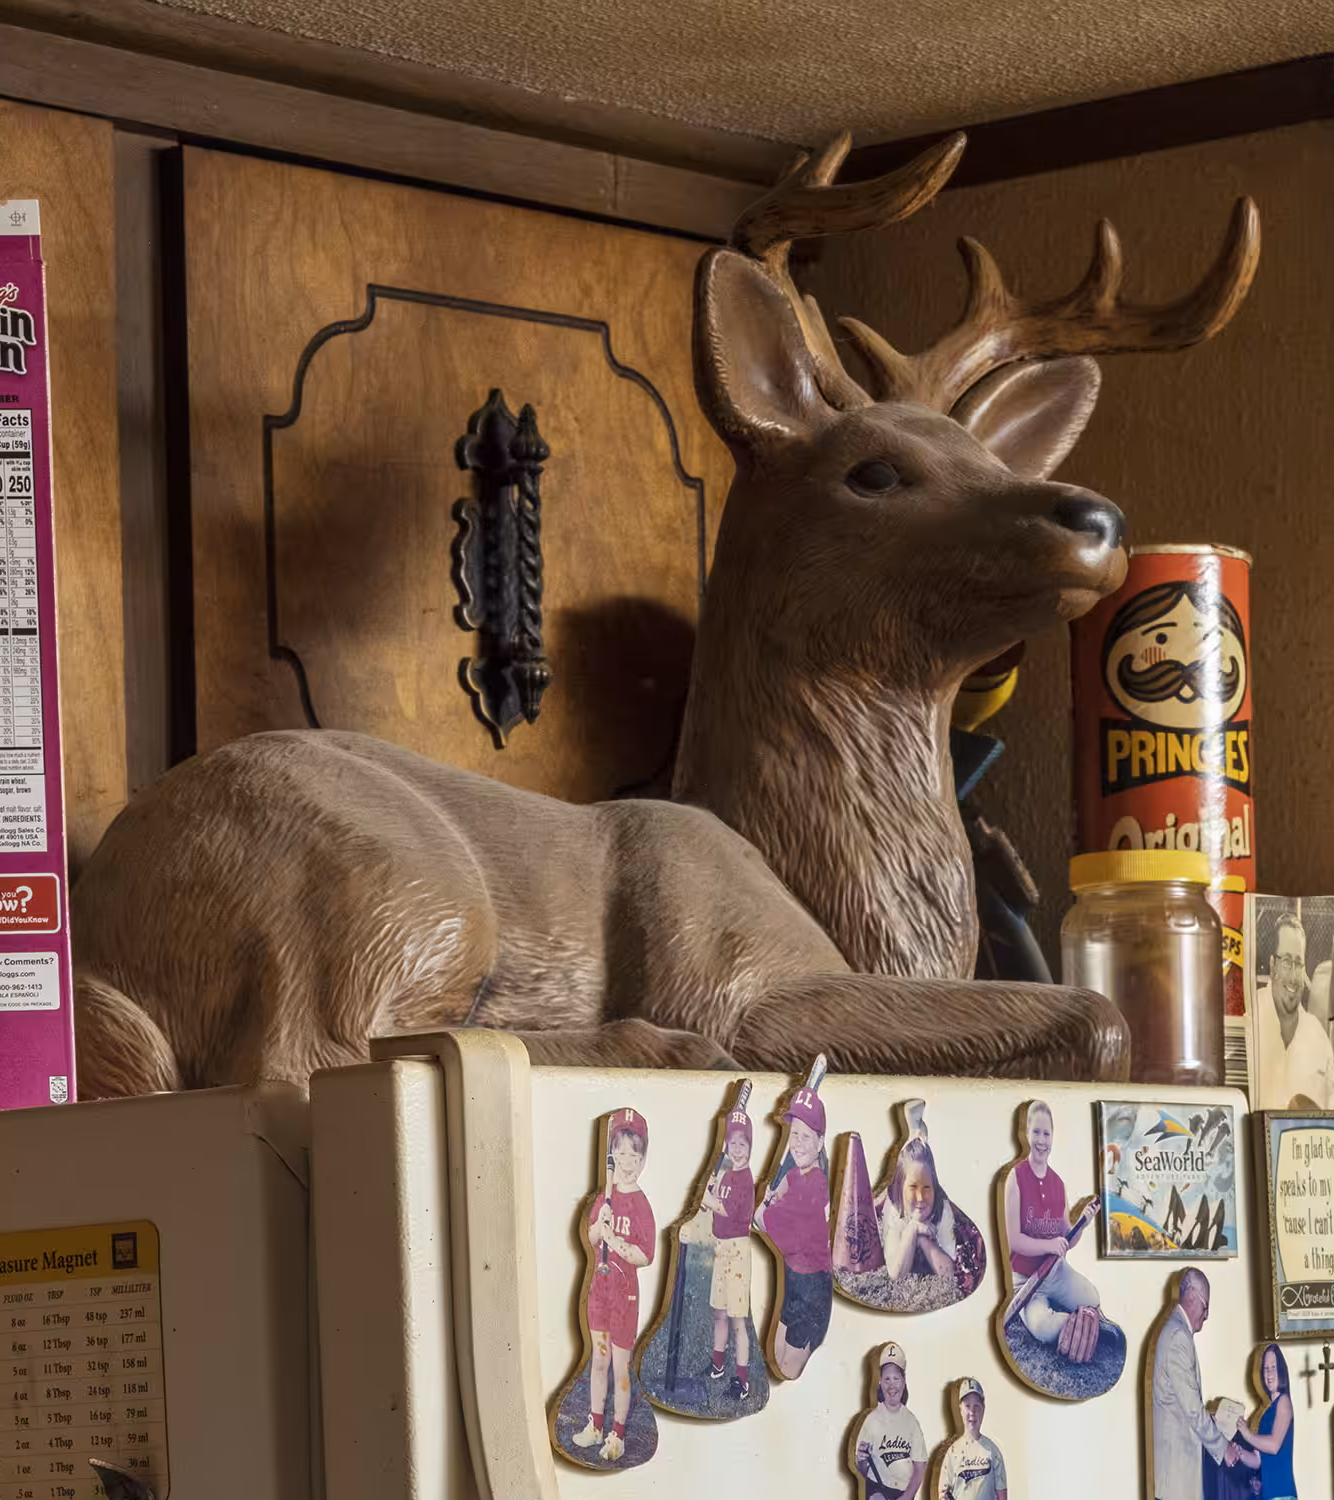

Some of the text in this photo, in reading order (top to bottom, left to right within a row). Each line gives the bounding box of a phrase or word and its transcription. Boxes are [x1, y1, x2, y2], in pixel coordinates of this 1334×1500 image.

[12, 440, 30, 450] (59g)
[9, 476, 31, 493] 250
[1108, 730, 1250, 783] PRINGES
[2, 815, 43, 823] INGREDIENTS.
[1107, 803, 1251, 859] Orignal
[4, 958, 54, 966] Comments?
[794, 1089, 814, 1110] LL
[624, 1109, 633, 1122] H
[1134, 1150, 1208, 1172] SeaWorld
[1292, 1137, 1302, 1160] I'm
[1304, 1136, 1323, 1167] glad
[1280, 1171, 1306, 1207] speaks
[1309, 1171, 1317, 1196] to
[1319, 1177, 1331, 1206] my
[1314, 1211, 1333, 1235] can't
[42, 1250, 98, 1273] Magnet
[53, 1313, 71, 1330] Tbsp
[95, 1312, 107, 1326] tsp
[119, 1308, 133, 1319] 237
[134, 1306, 145, 1318] ml
[53, 1331, 146, 1351] Tbsp tsp 177 ml
